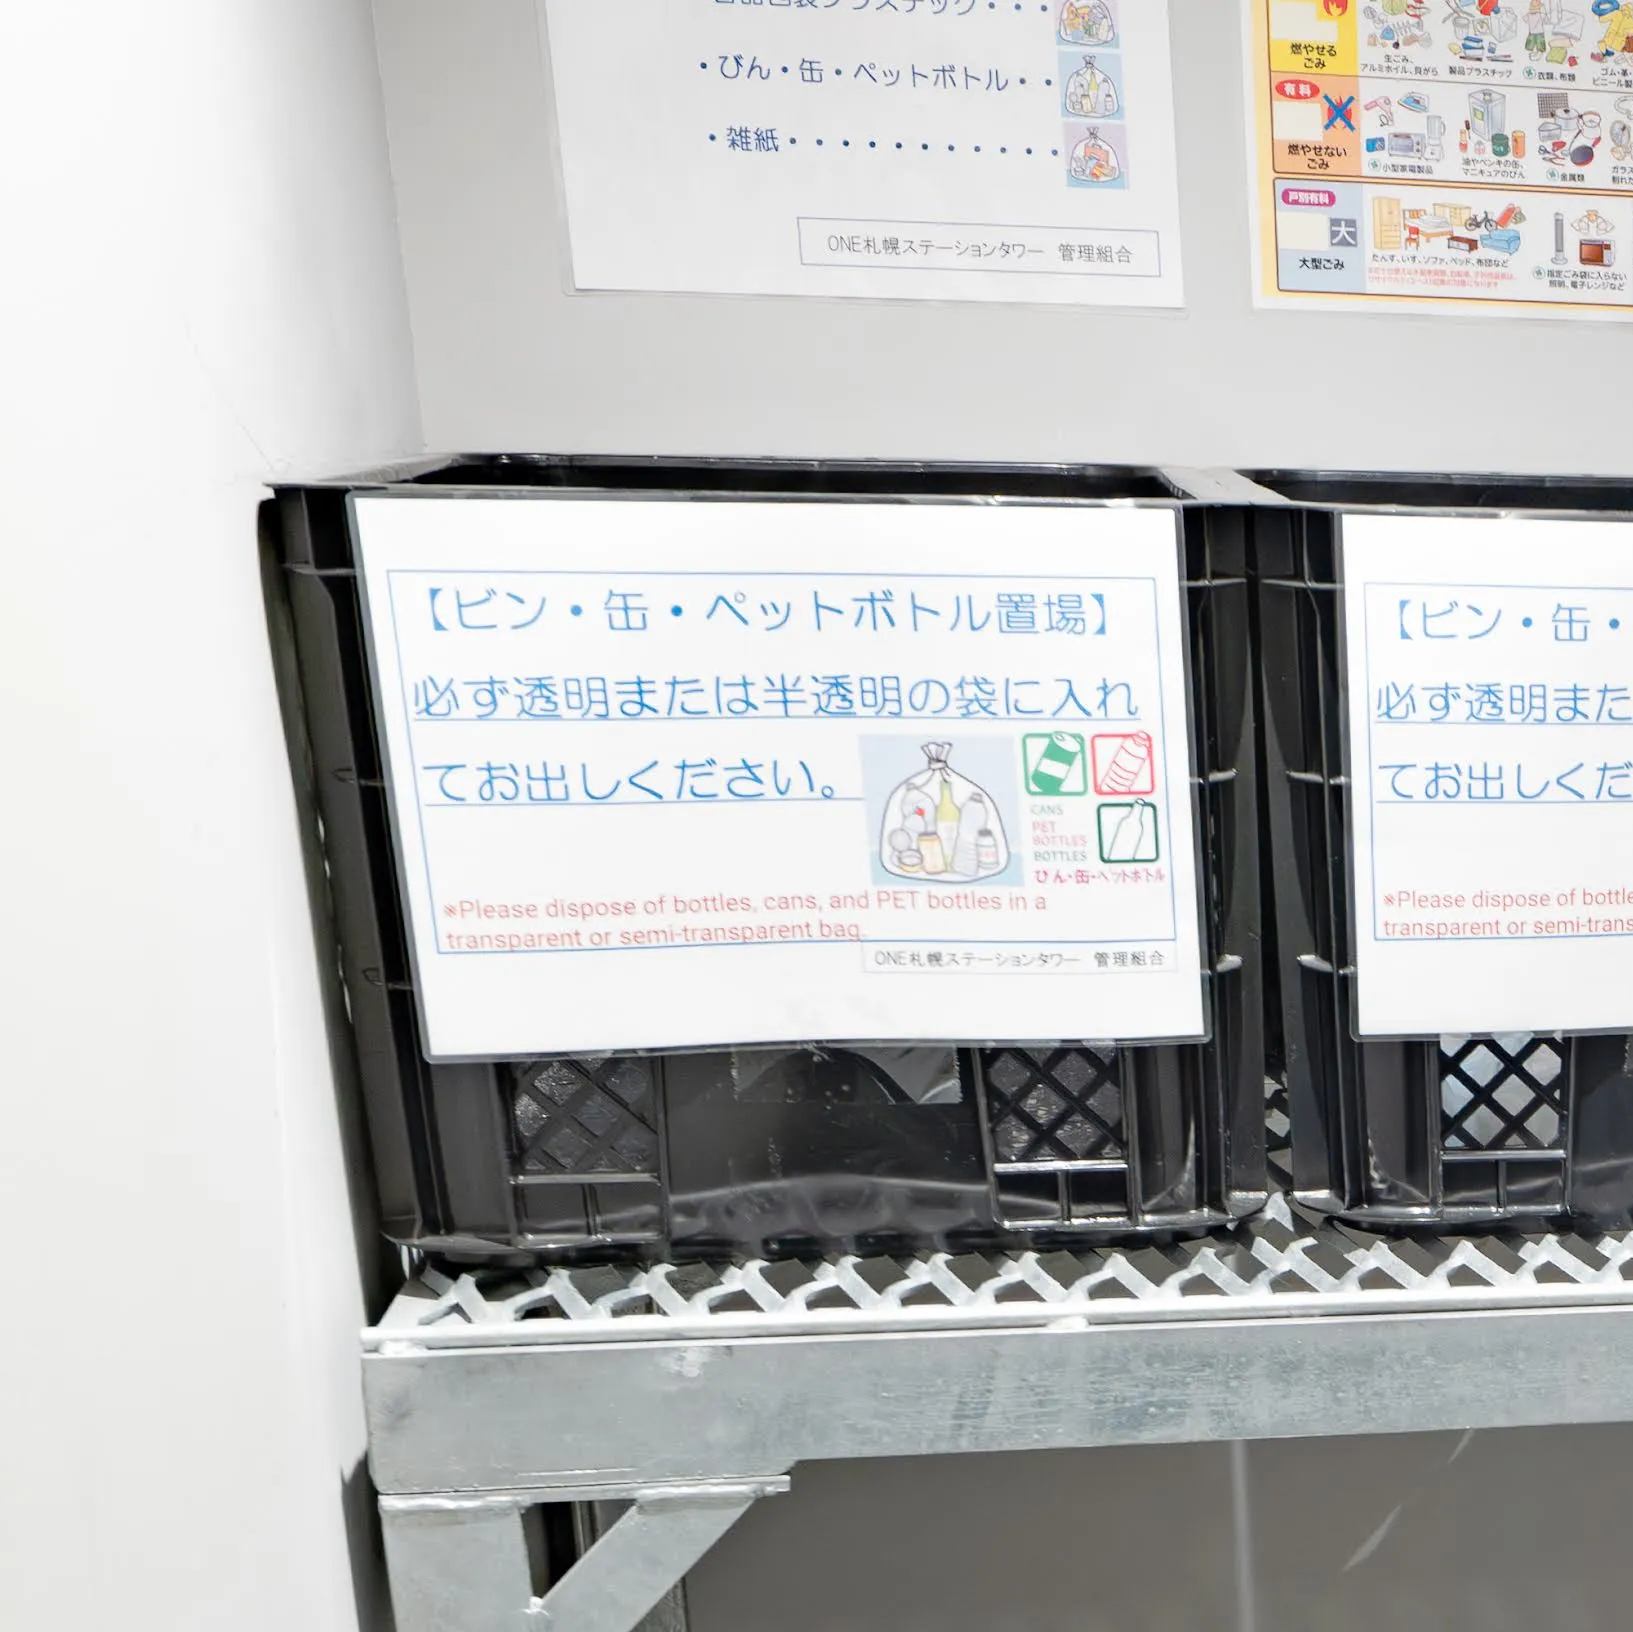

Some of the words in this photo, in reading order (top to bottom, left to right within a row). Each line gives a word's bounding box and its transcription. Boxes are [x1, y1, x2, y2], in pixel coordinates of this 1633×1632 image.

[1290, 43, 1337, 57] 燃やせる
[1304, 57, 1326, 69] ごみ
[1449, 66, 1512, 78] 製品プラスチック
[1284, 83, 1312, 97] 有料
[1288, 143, 1346, 157] 燃やせない
[1307, 158, 1329, 170] ごみ
[1332, 220, 1356, 244] 大
[827, 235, 1044, 258] ONE札幌ステーションタワー
[1058, 243, 1133, 264] 管理組合
[1299, 257, 1344, 270] 大型ごみ
[428, 587, 1106, 637] 【ビン・缶・ペットボトル置場】
[413, 676, 1139, 718] 必ず透明または半透明の袋に入れ
[423, 757, 836, 802] てお出しください。
[546, 898, 636, 921] dispose
[644, 895, 665, 915] of
[674, 893, 757, 914] bottles,
[764, 894, 823, 913] cans,
[829, 891, 869, 910] and
[877, 891, 919, 909] PET
[928, 890, 1002, 910] bottles
[1009, 891, 1027, 911] in
[1035, 895, 1047, 911] a
[447, 930, 583, 952] transparent
[589, 930, 612, 947] or
[620, 922, 812, 945] semi-transparent
[875, 952, 1081, 967] ONE札幌ステーションタワー
[1094, 951, 1165, 968] 管理組合
